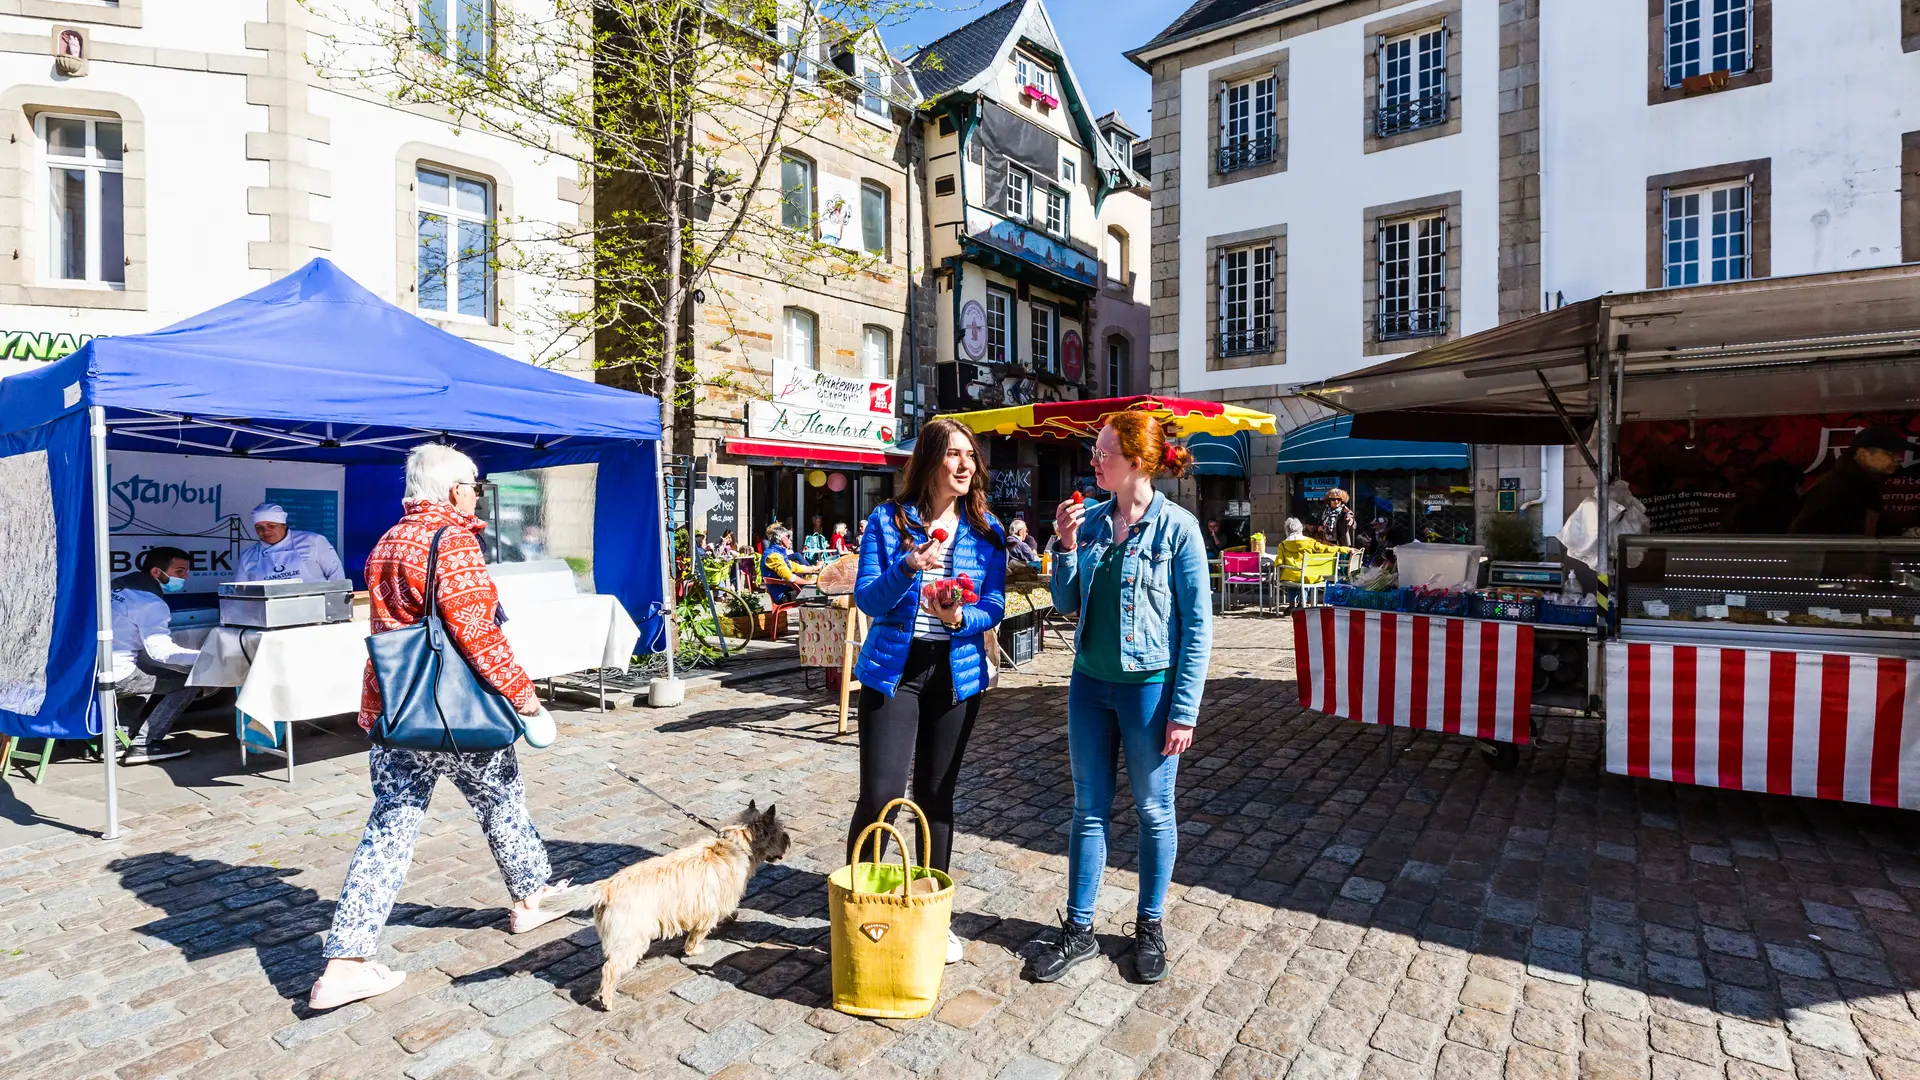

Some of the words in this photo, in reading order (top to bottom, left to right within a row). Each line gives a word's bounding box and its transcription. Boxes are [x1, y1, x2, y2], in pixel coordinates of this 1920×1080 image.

[1005, 487, 1020, 500] BAR
[1654, 493, 1676, 504] jours
[1678, 491, 1691, 499] de
[1693, 491, 1736, 499] marchés
[1665, 501, 1701, 510] PAIMPOL
